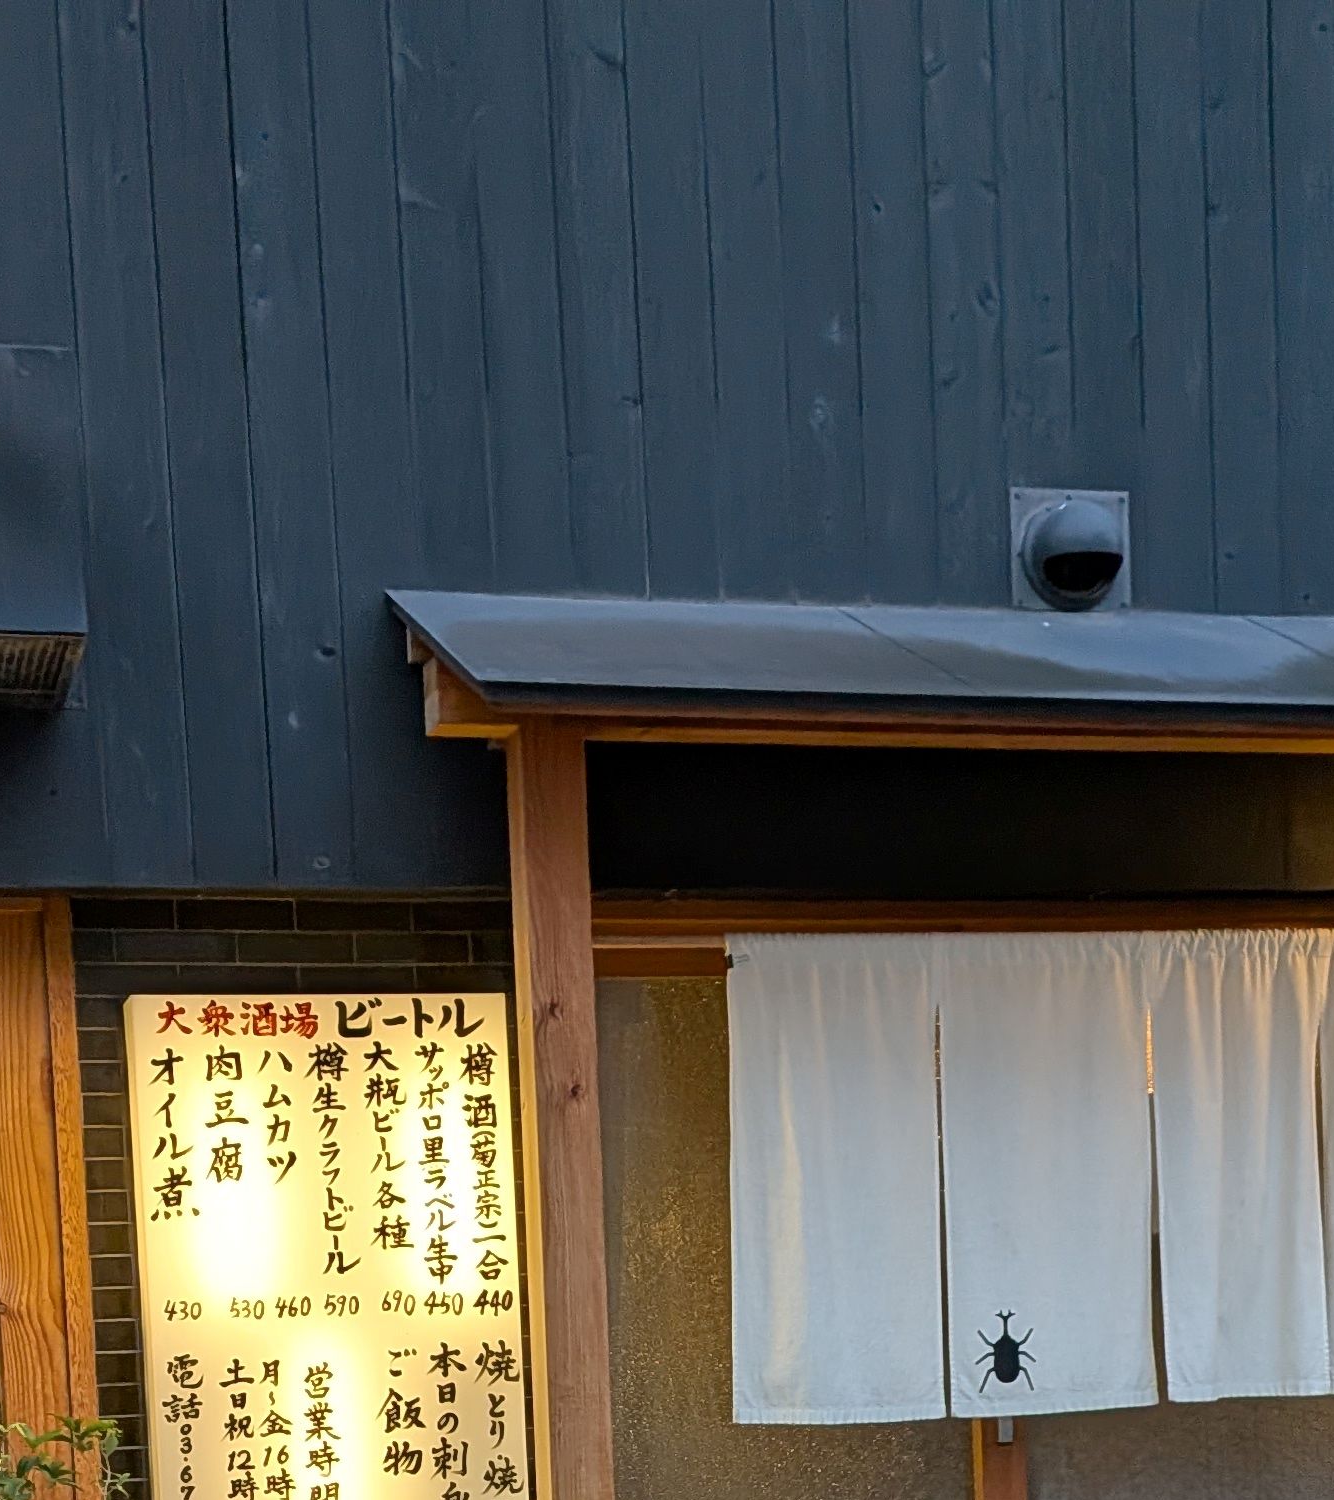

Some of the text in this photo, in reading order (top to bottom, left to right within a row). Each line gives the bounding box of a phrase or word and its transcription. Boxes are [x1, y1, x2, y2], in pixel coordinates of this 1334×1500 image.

[156, 999, 485, 1039] 大衆酒場 ビートル
[148, 1048, 201, 1321] オイル煮 430
[205, 1045, 264, 1320] 肉豆腐 530
[258, 1049, 311, 1318] ハムカツ 460
[324, 1295, 359, 1316] 590
[382, 1290, 415, 1316] 690
[423, 1291, 463, 1316] 450
[473, 1289, 513, 1315] 440
[376, 1348, 427, 1475] ご飯物
